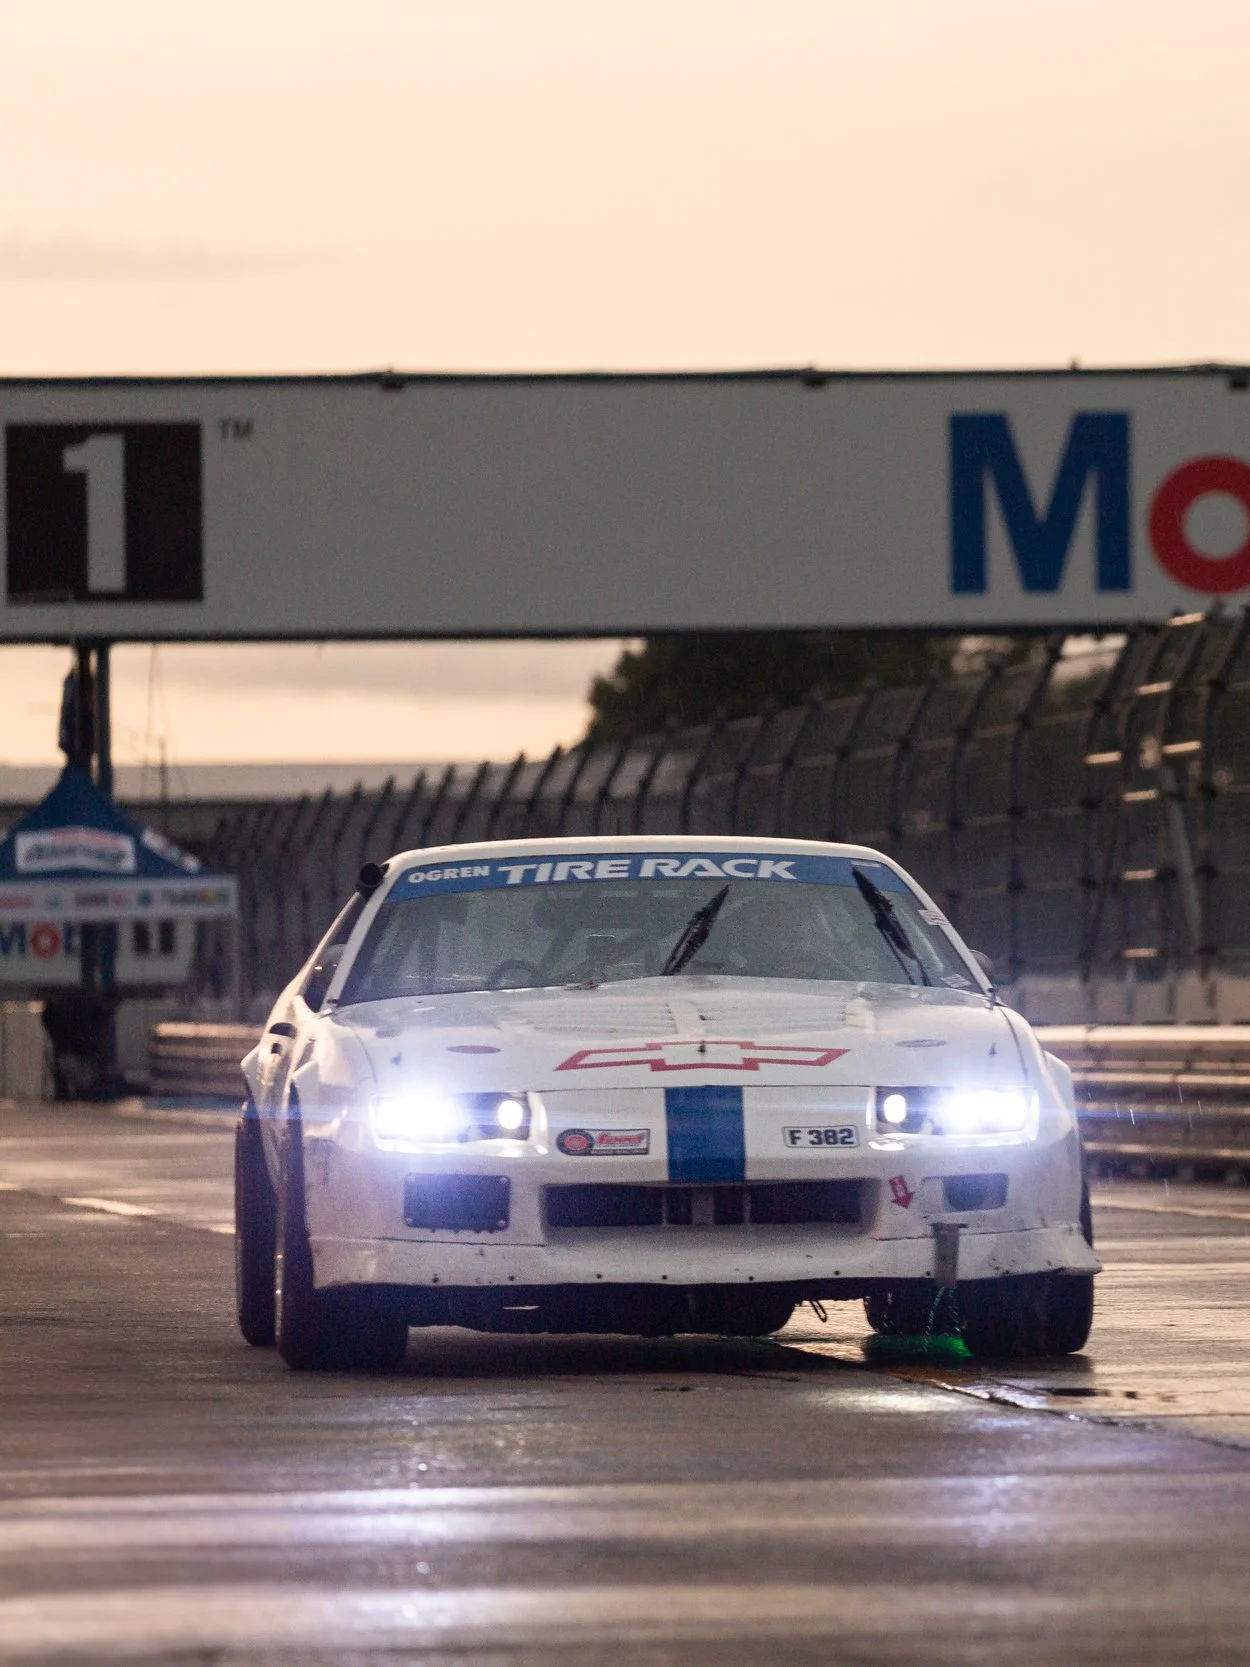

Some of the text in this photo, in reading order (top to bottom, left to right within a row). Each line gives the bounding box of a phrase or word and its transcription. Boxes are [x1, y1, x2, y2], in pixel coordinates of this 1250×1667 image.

[62, 418, 254, 592] 1 TM
[408, 858, 798, 885] OGREN TIRE RACK
[789, 1128, 854, 1145] F 382
